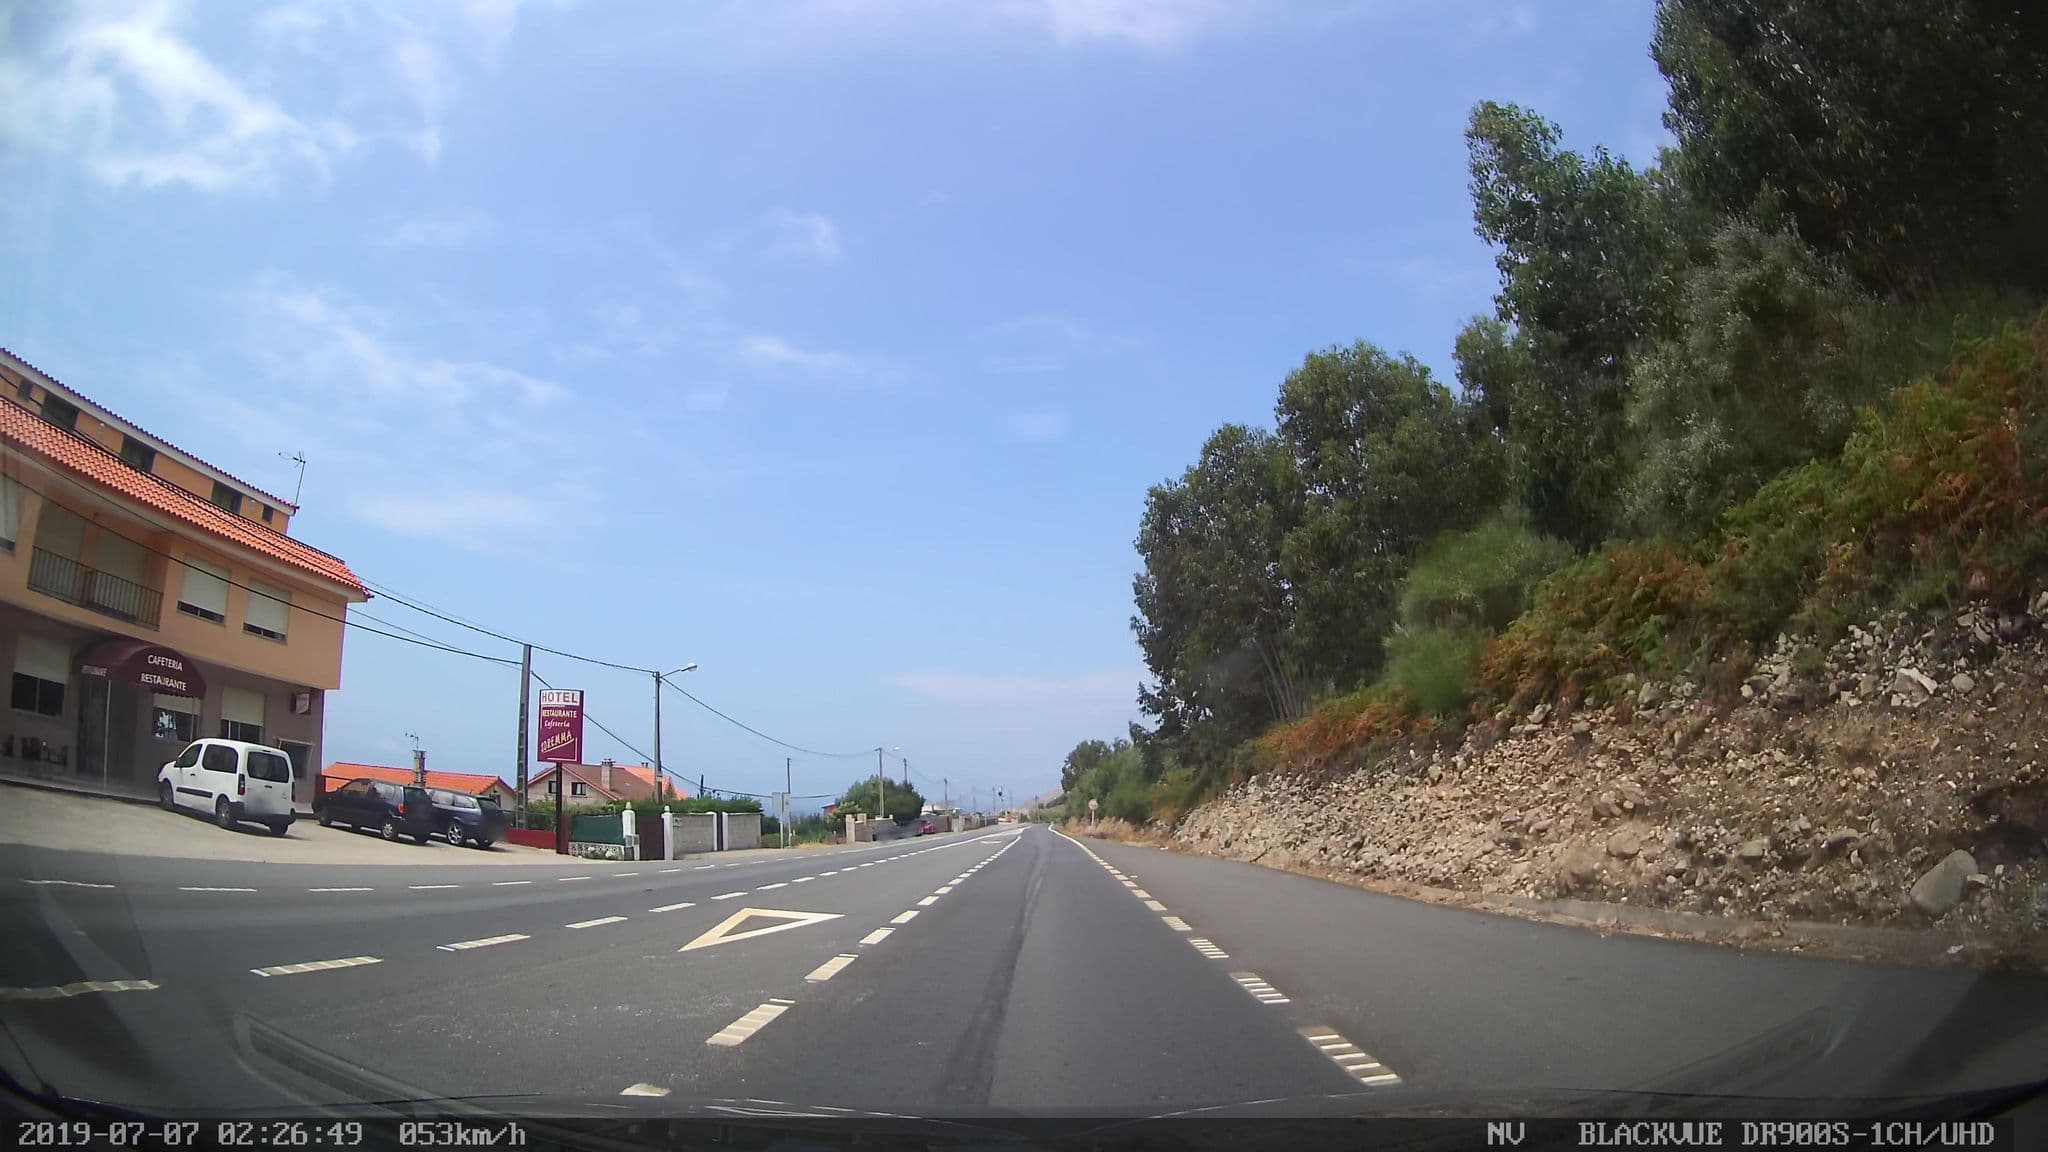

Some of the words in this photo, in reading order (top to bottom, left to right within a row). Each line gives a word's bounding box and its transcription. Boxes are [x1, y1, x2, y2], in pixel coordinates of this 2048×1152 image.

[147, 654, 183, 672] CAFETERIA
[140, 673, 187, 691] RESTAURANTE
[541, 691, 578, 704] HOTEL
[542, 709, 577, 718] RESTAURANTE
